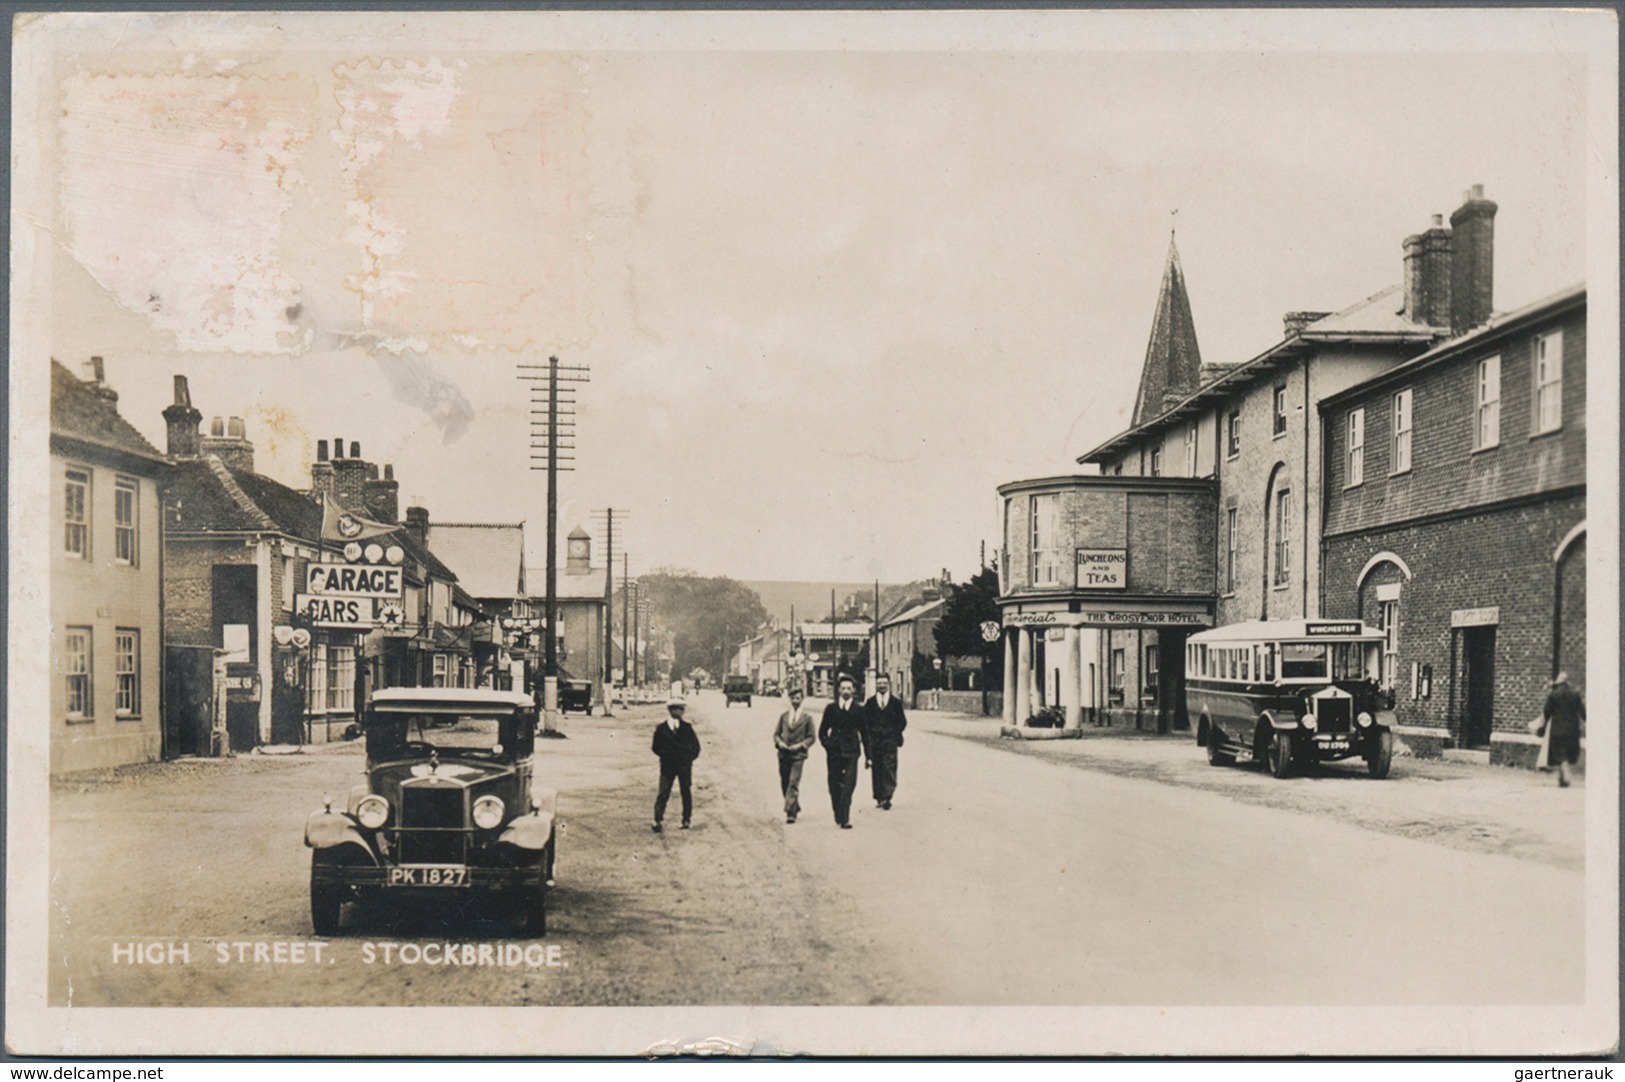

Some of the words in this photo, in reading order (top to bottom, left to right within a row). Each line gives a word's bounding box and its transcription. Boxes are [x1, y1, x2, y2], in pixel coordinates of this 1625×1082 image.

[308, 599, 360, 623] CARS
[1087, 613, 1106, 622] THE
[1109, 613, 1165, 623] GROSVENOR
[1168, 614, 1201, 624] HOTEL
[391, 869, 415, 884] PK
[422, 869, 466, 884] 1827
